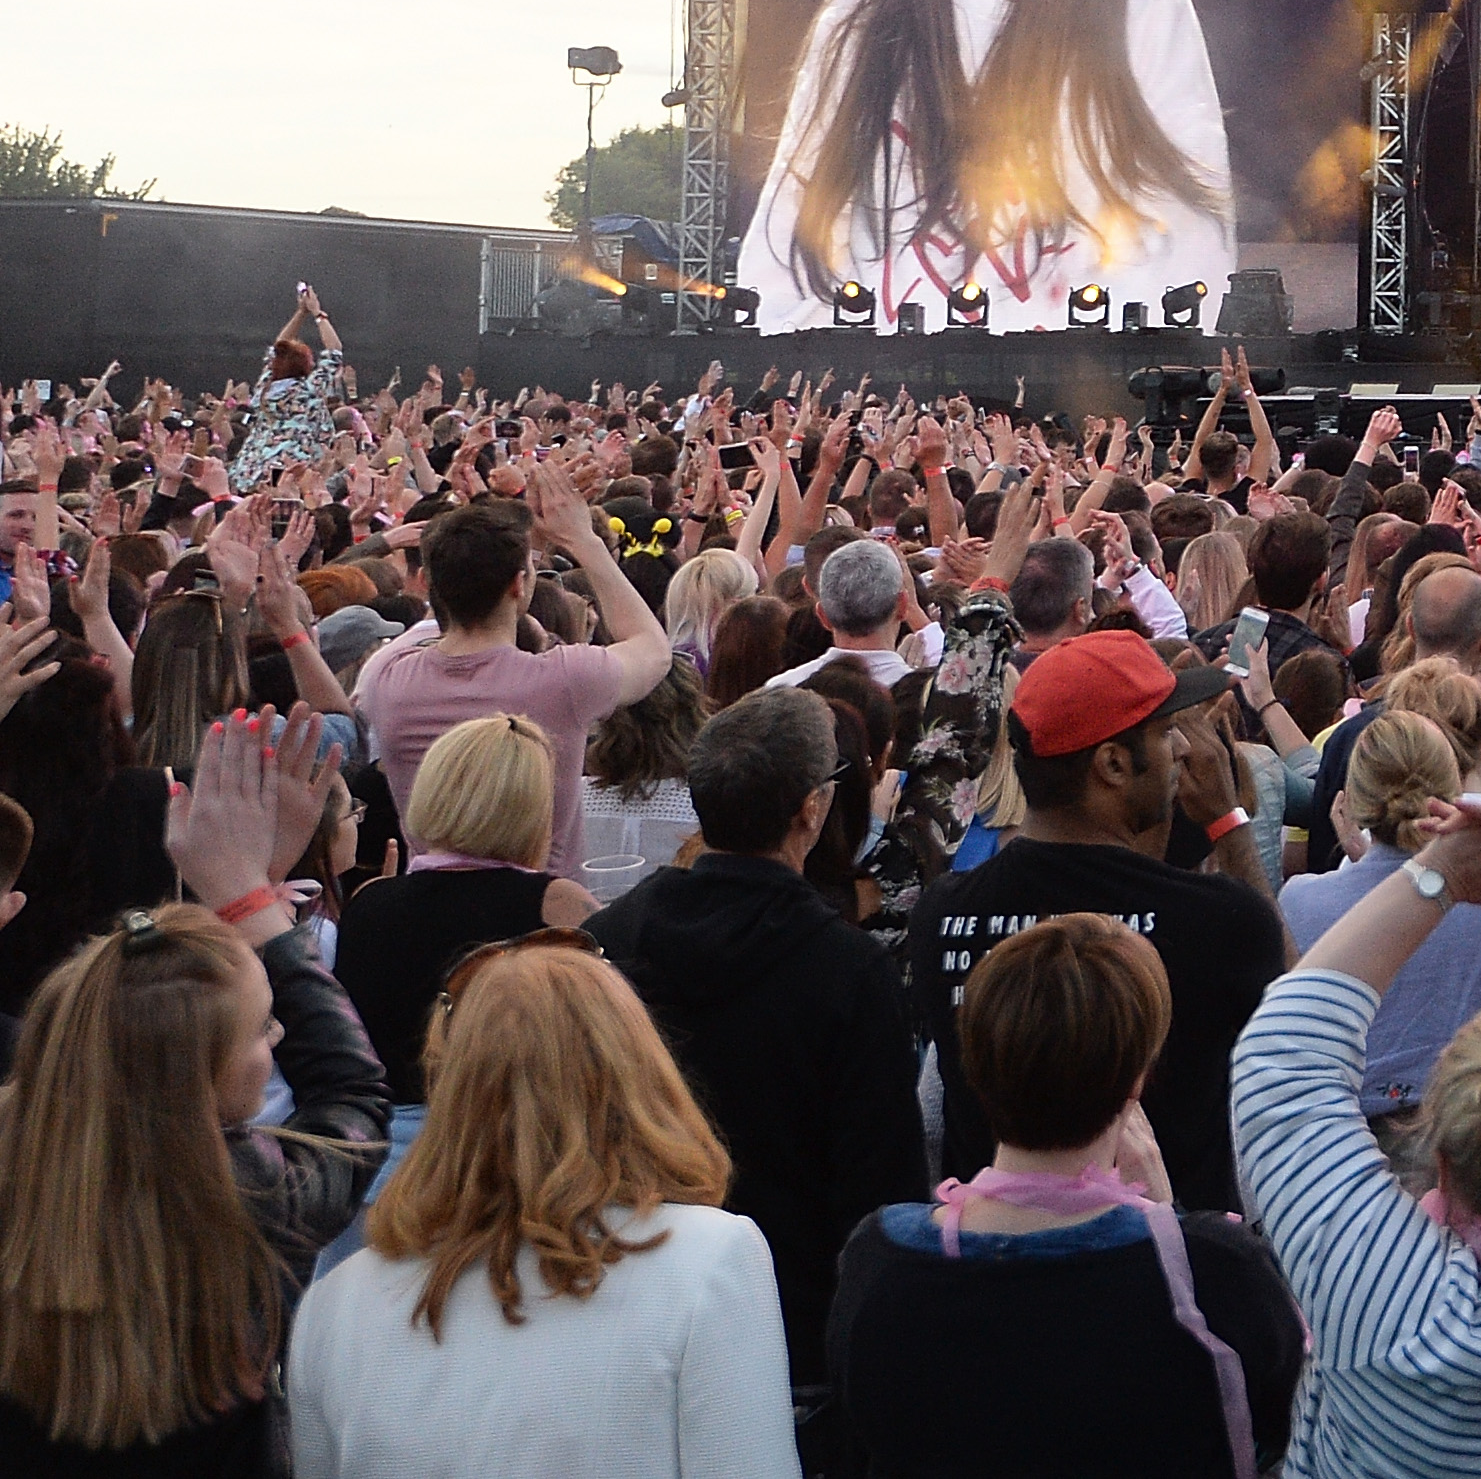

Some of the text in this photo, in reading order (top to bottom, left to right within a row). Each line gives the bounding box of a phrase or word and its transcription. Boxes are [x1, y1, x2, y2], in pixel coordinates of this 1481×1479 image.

[940, 912, 1156, 937] THE MAN AS
[943, 950, 971, 971] NO
